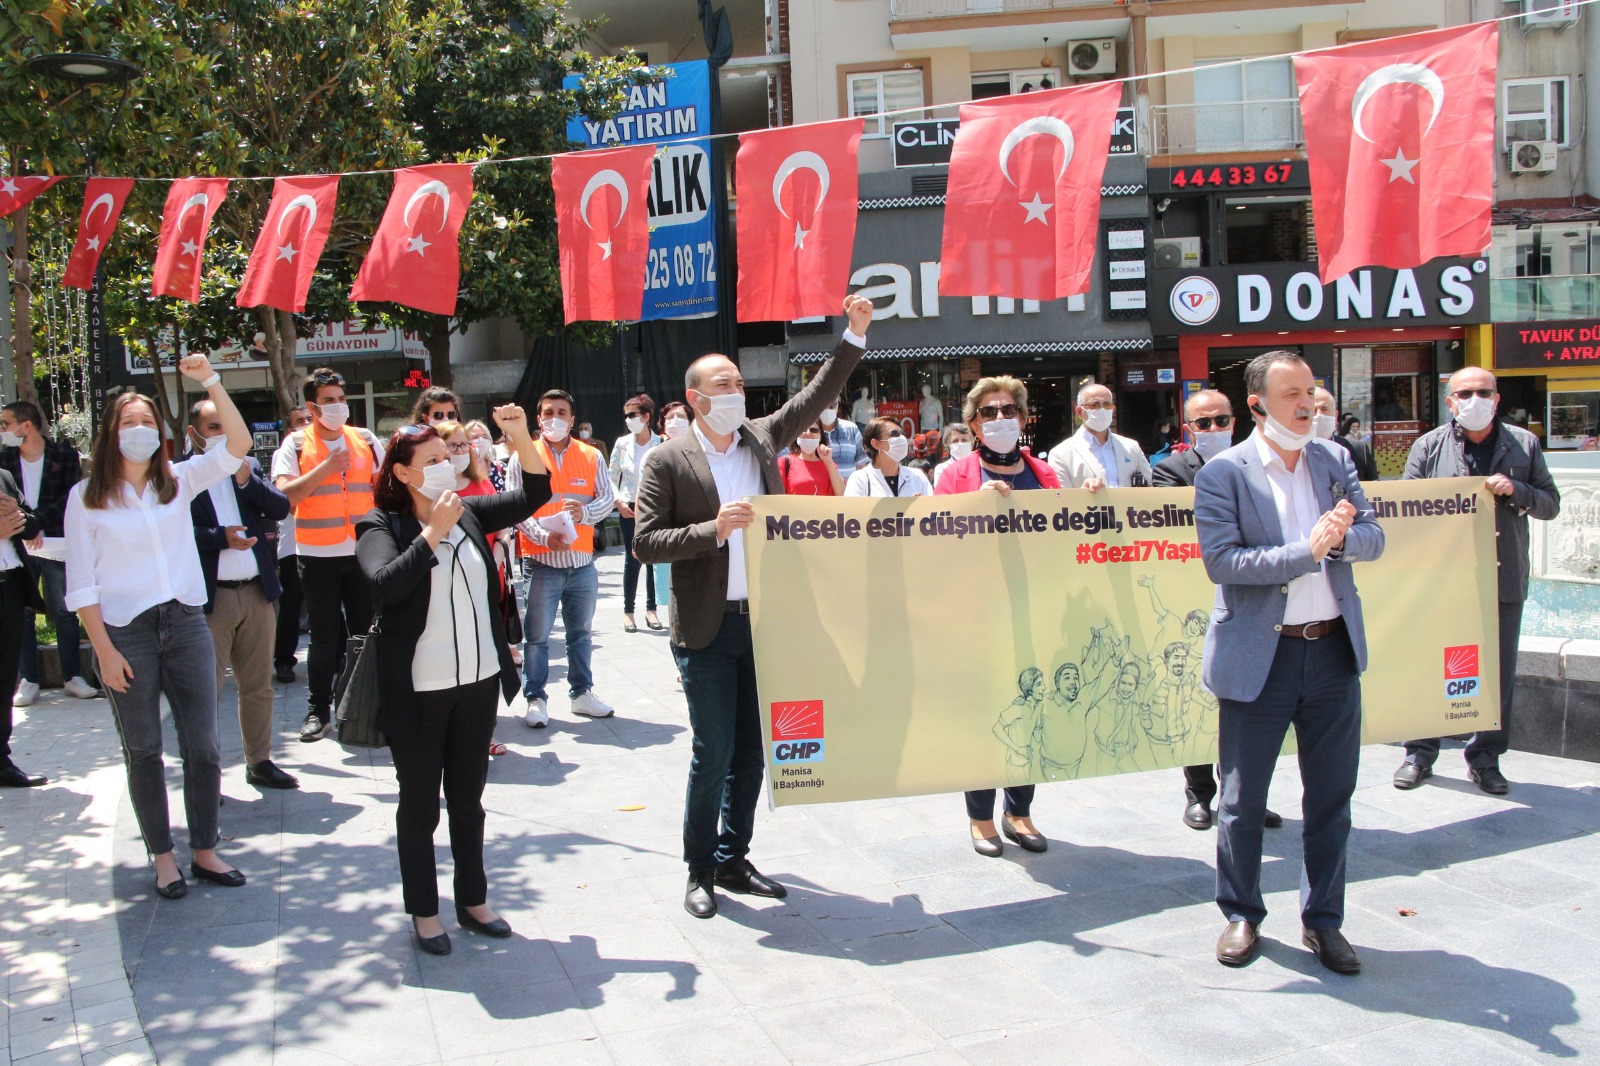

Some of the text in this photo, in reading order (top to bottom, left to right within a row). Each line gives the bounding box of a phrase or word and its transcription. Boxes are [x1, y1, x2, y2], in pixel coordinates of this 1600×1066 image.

[584, 107, 697, 145] YATIRIM
[897, 118, 1134, 148] CLİN K
[1171, 164, 1293, 188] 444 33 67
[673, 244, 695, 287] 08
[697, 240, 717, 283] 72
[1237, 265, 1474, 323] DONAS
[306, 338, 379, 352] GÜNAYDIN
[1519, 329, 1576, 344] TAVUK
[765, 513, 861, 540] Mesele
[866, 512, 915, 538] esir
[919, 508, 1048, 540] düşmekte
[1052, 505, 1123, 535] değil,
[1367, 496, 1398, 518] ün
[1401, 493, 1477, 517] mesele!
[1076, 539, 1202, 564] #Gezi7Yaşı
[1447, 680, 1477, 696] CHP
[1449, 710, 1480, 720] Başkanlığı
[1451, 701, 1471, 709] Manisa
[775, 741, 821, 761] CHP
[781, 766, 812, 776] Manisa
[779, 777, 825, 789] Başkanlığı
